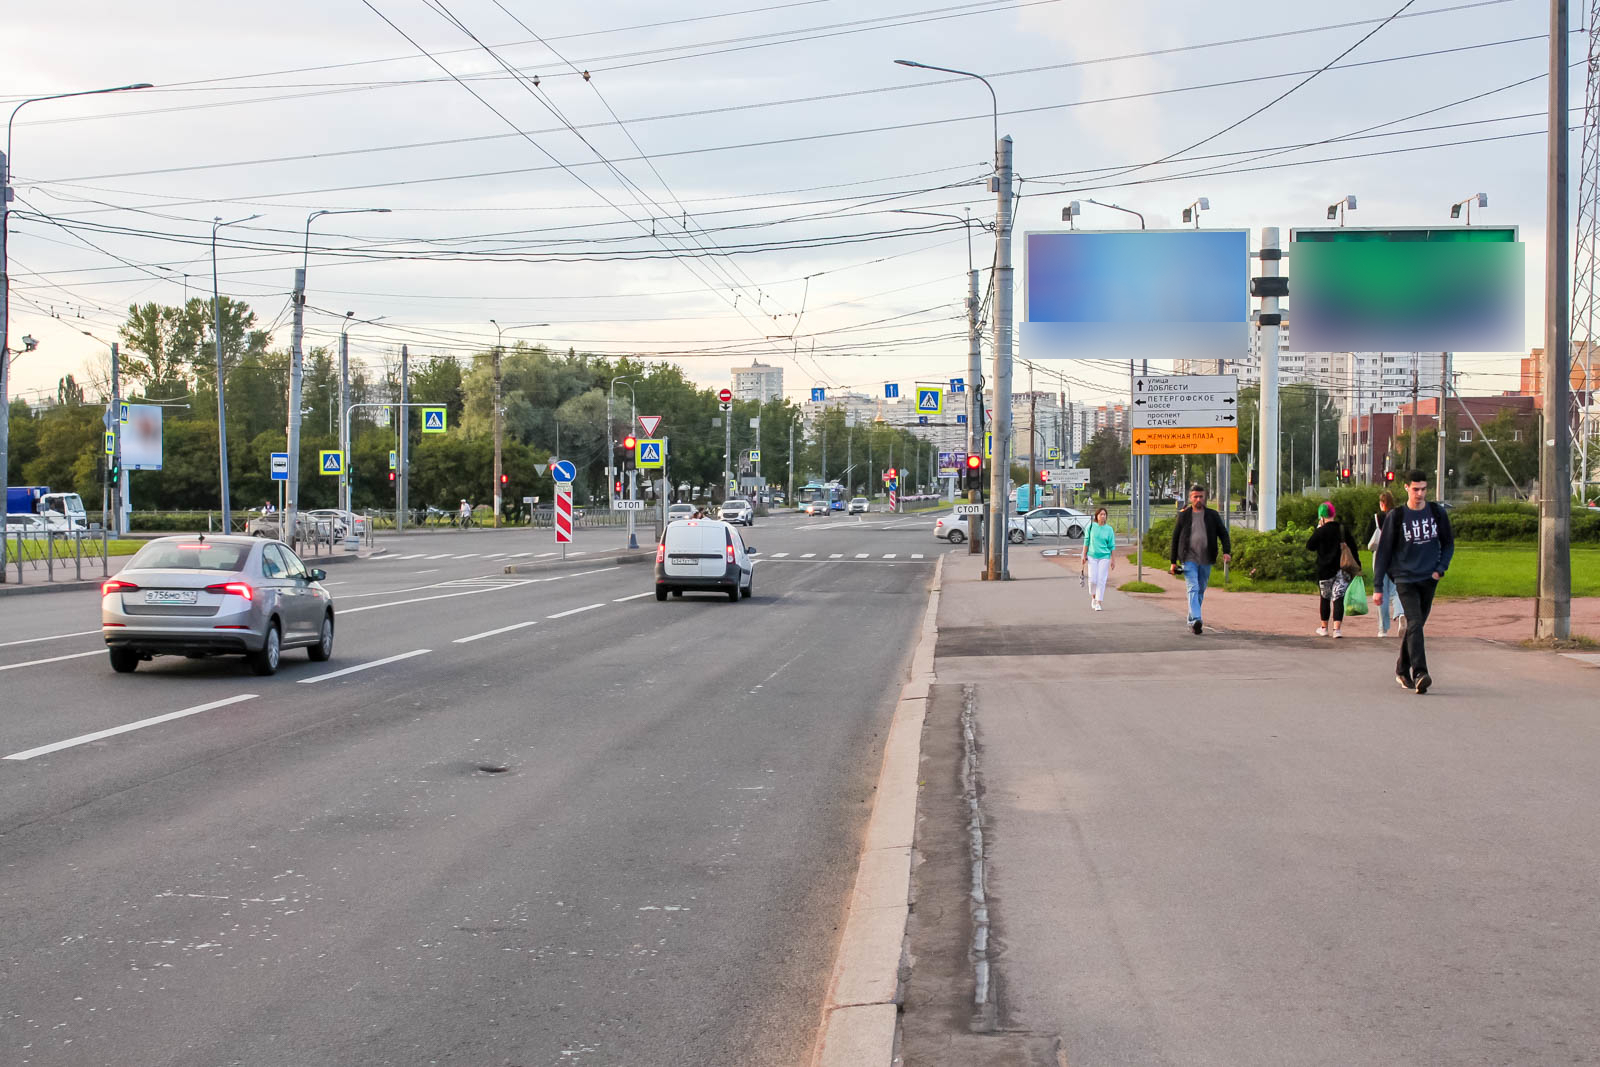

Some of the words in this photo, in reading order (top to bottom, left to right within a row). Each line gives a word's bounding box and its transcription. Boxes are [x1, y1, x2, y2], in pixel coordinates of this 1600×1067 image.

[1147, 384, 1189, 392] ДОБЛЕСТИ
[1147, 394, 1215, 402] ПЕТЕРГОФСКОЕ
[617, 501, 640, 509] СТОП
[957, 505, 979, 513] СТОП
[1402, 522, 1438, 538] LUCK
